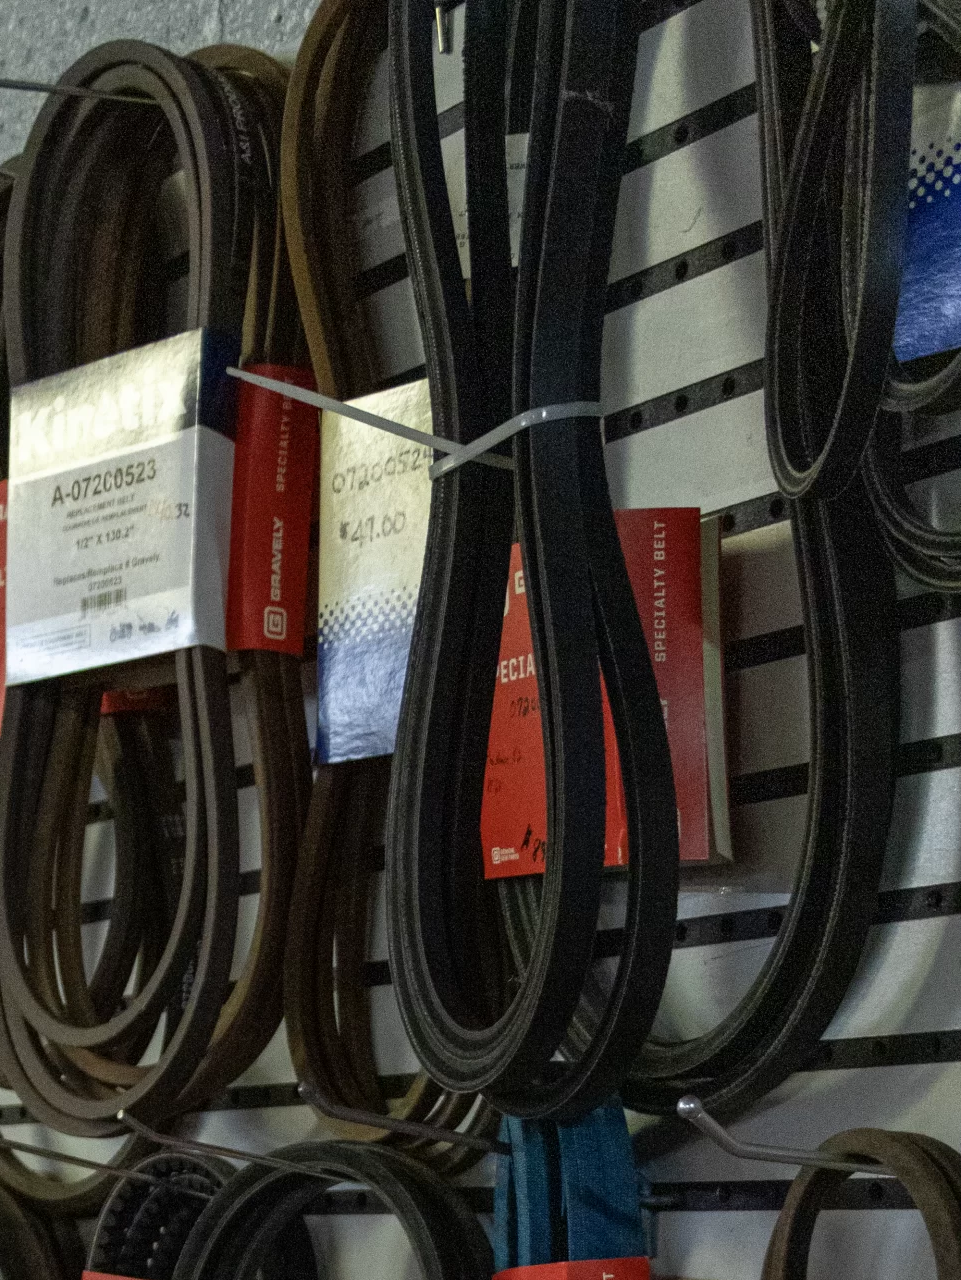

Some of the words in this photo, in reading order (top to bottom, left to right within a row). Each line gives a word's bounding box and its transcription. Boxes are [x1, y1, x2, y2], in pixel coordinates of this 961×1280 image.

[51, 458, 157, 508] A-07200523
[271, 517, 284, 601] GRAVELY
[653, 520, 668, 562] BELT
[653, 567, 668, 663] SPECIALTY
